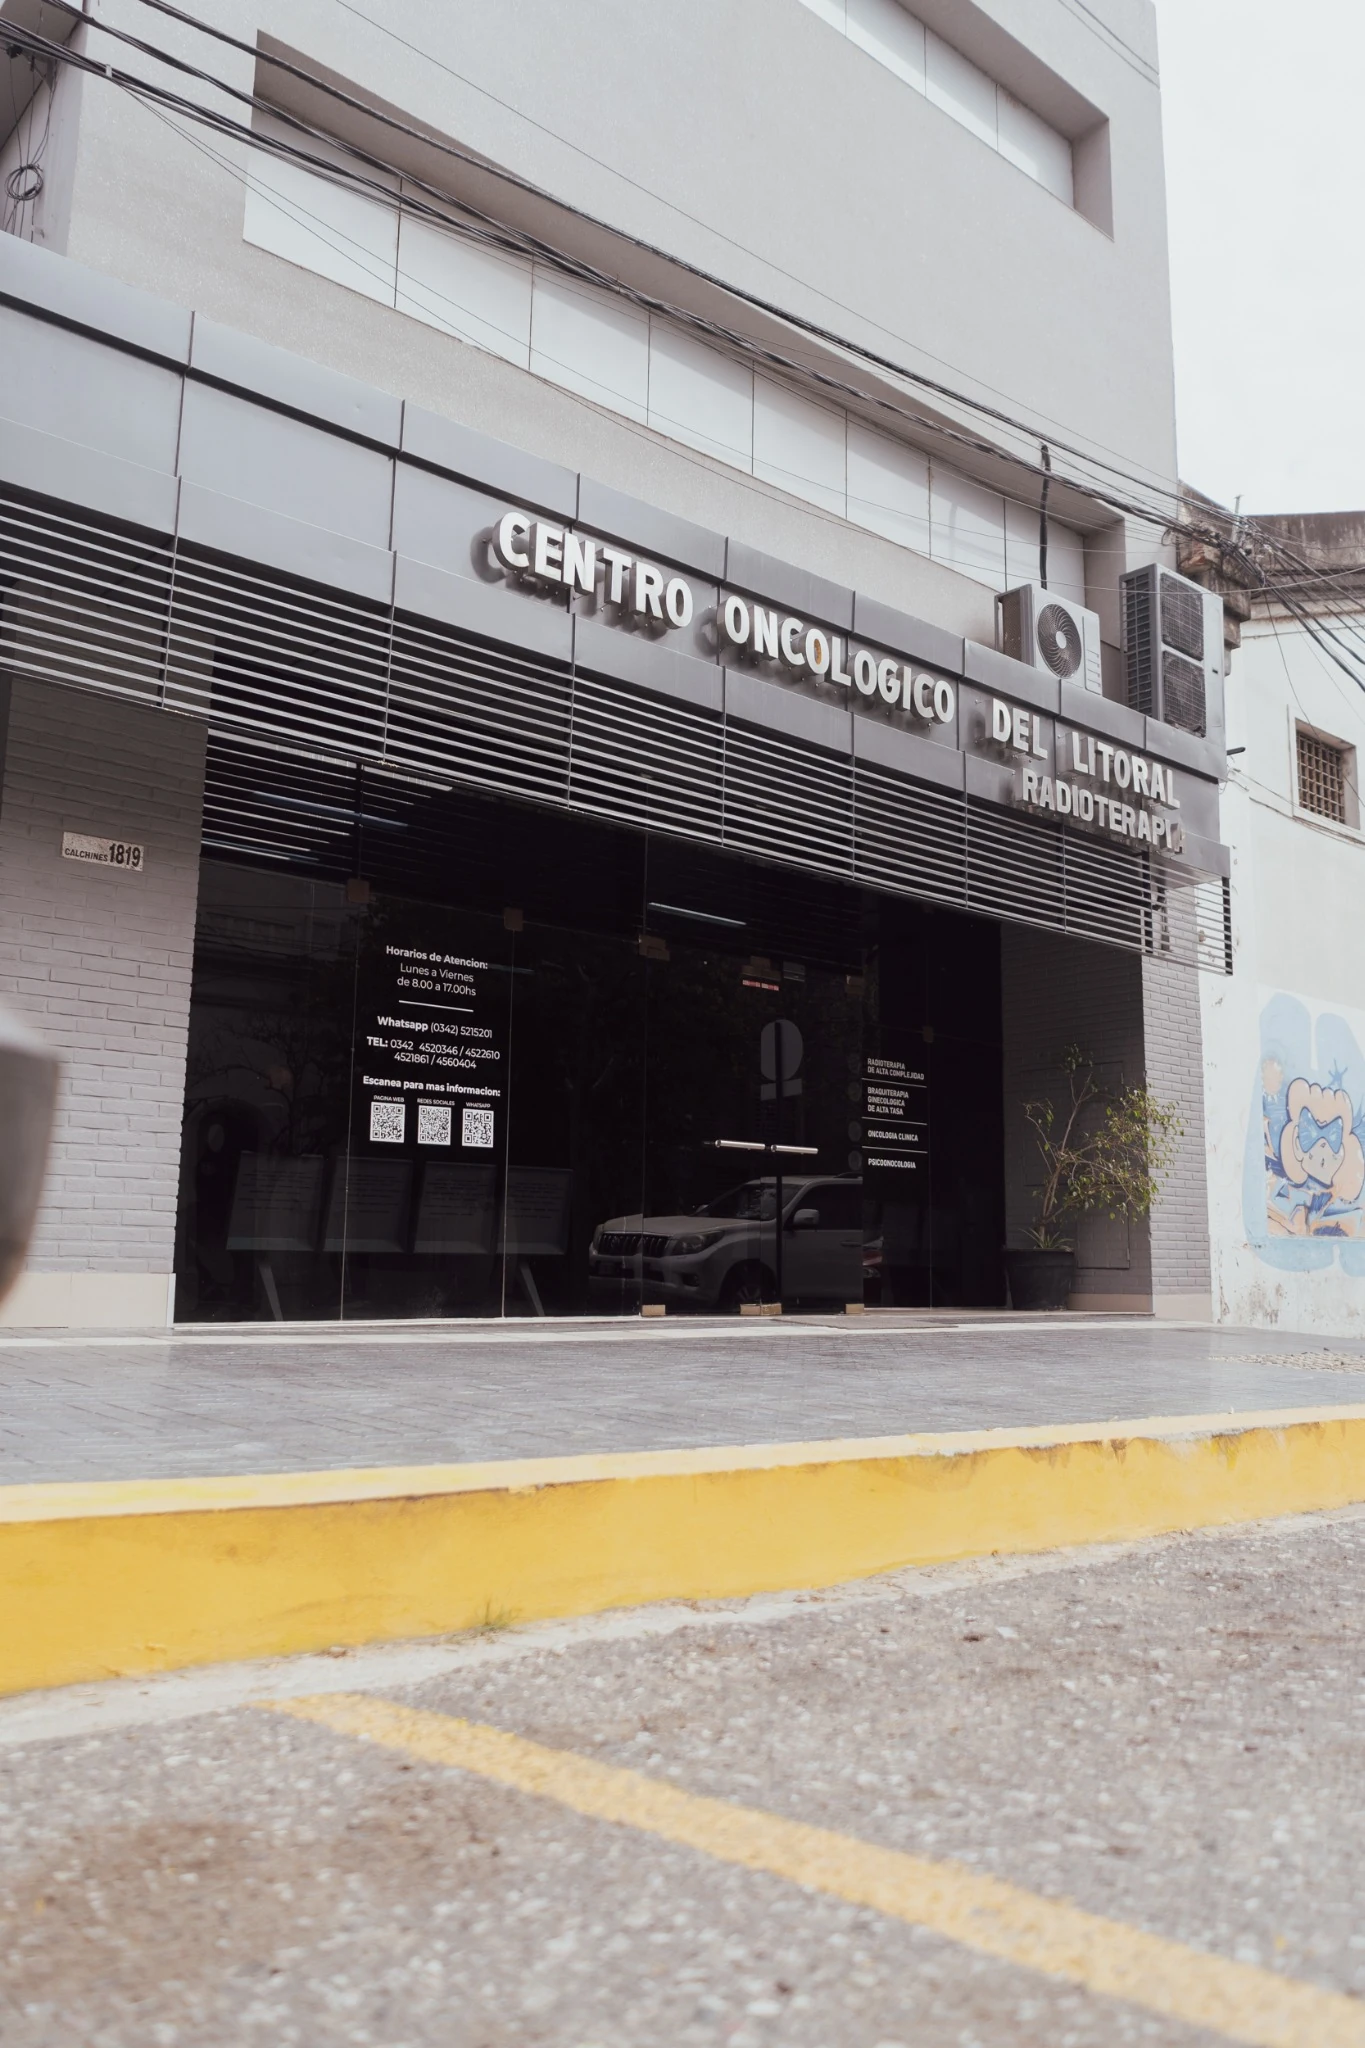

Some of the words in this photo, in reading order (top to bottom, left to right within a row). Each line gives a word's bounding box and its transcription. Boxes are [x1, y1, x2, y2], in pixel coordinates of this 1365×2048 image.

[499, 512, 694, 628] CENTRO
[724, 595, 955, 723] ONCOLOGICO
[992, 698, 1048, 760] DEL
[1072, 731, 1181, 809] LITORAL
[64, 848, 108, 862] CALCHINES
[109, 843, 141, 867] 1819
[386, 945, 428, 961] Horarios
[429, 952, 442, 963] de
[443, 954, 488, 970] Atencion:
[400, 963, 430, 977] Lunes
[431, 968, 437, 978] a
[439, 969, 474, 983] Viernes
[397, 976, 410, 987] de
[411, 978, 433, 990] 8.00
[434, 982, 441, 991] a
[442, 982, 477, 996] 17.00hs
[377, 1015, 429, 1032] Whatsapp
[430, 1022, 459, 1036] (0342)
[460, 1025, 493, 1039] 5215201
[366, 1036, 388, 1048] TEL:
[390, 1039, 414, 1050] 0342
[419, 1042, 458, 1056] 4520346
[465, 1047, 500, 1060] 4522610
[394, 1052, 430, 1064] 4521861
[436, 1056, 477, 1069] 4560404
[868, 1058, 906, 1070] RADIOTERAPIA
[868, 1066, 875, 1074] DE
[876, 1067, 889, 1076] ALTA
[889, 1069, 925, 1080] COMPLEJIDAD
[363, 1075, 402, 1088] Escanea
[403, 1080, 424, 1091] para
[426, 1083, 445, 1092] mas
[446, 1083, 501, 1097] informacion:
[868, 1086, 909, 1098] BRAQUITERAPIA
[417, 1097, 432, 1105] REDES
[868, 1095, 906, 1107] GINECOLOGICA
[868, 1104, 875, 1112] DE
[876, 1105, 889, 1114] ALTA
[890, 1107, 904, 1115] TASA
[868, 1130, 898, 1140] ONCOLOGIA
[898, 1132, 919, 1141] CLINICA
